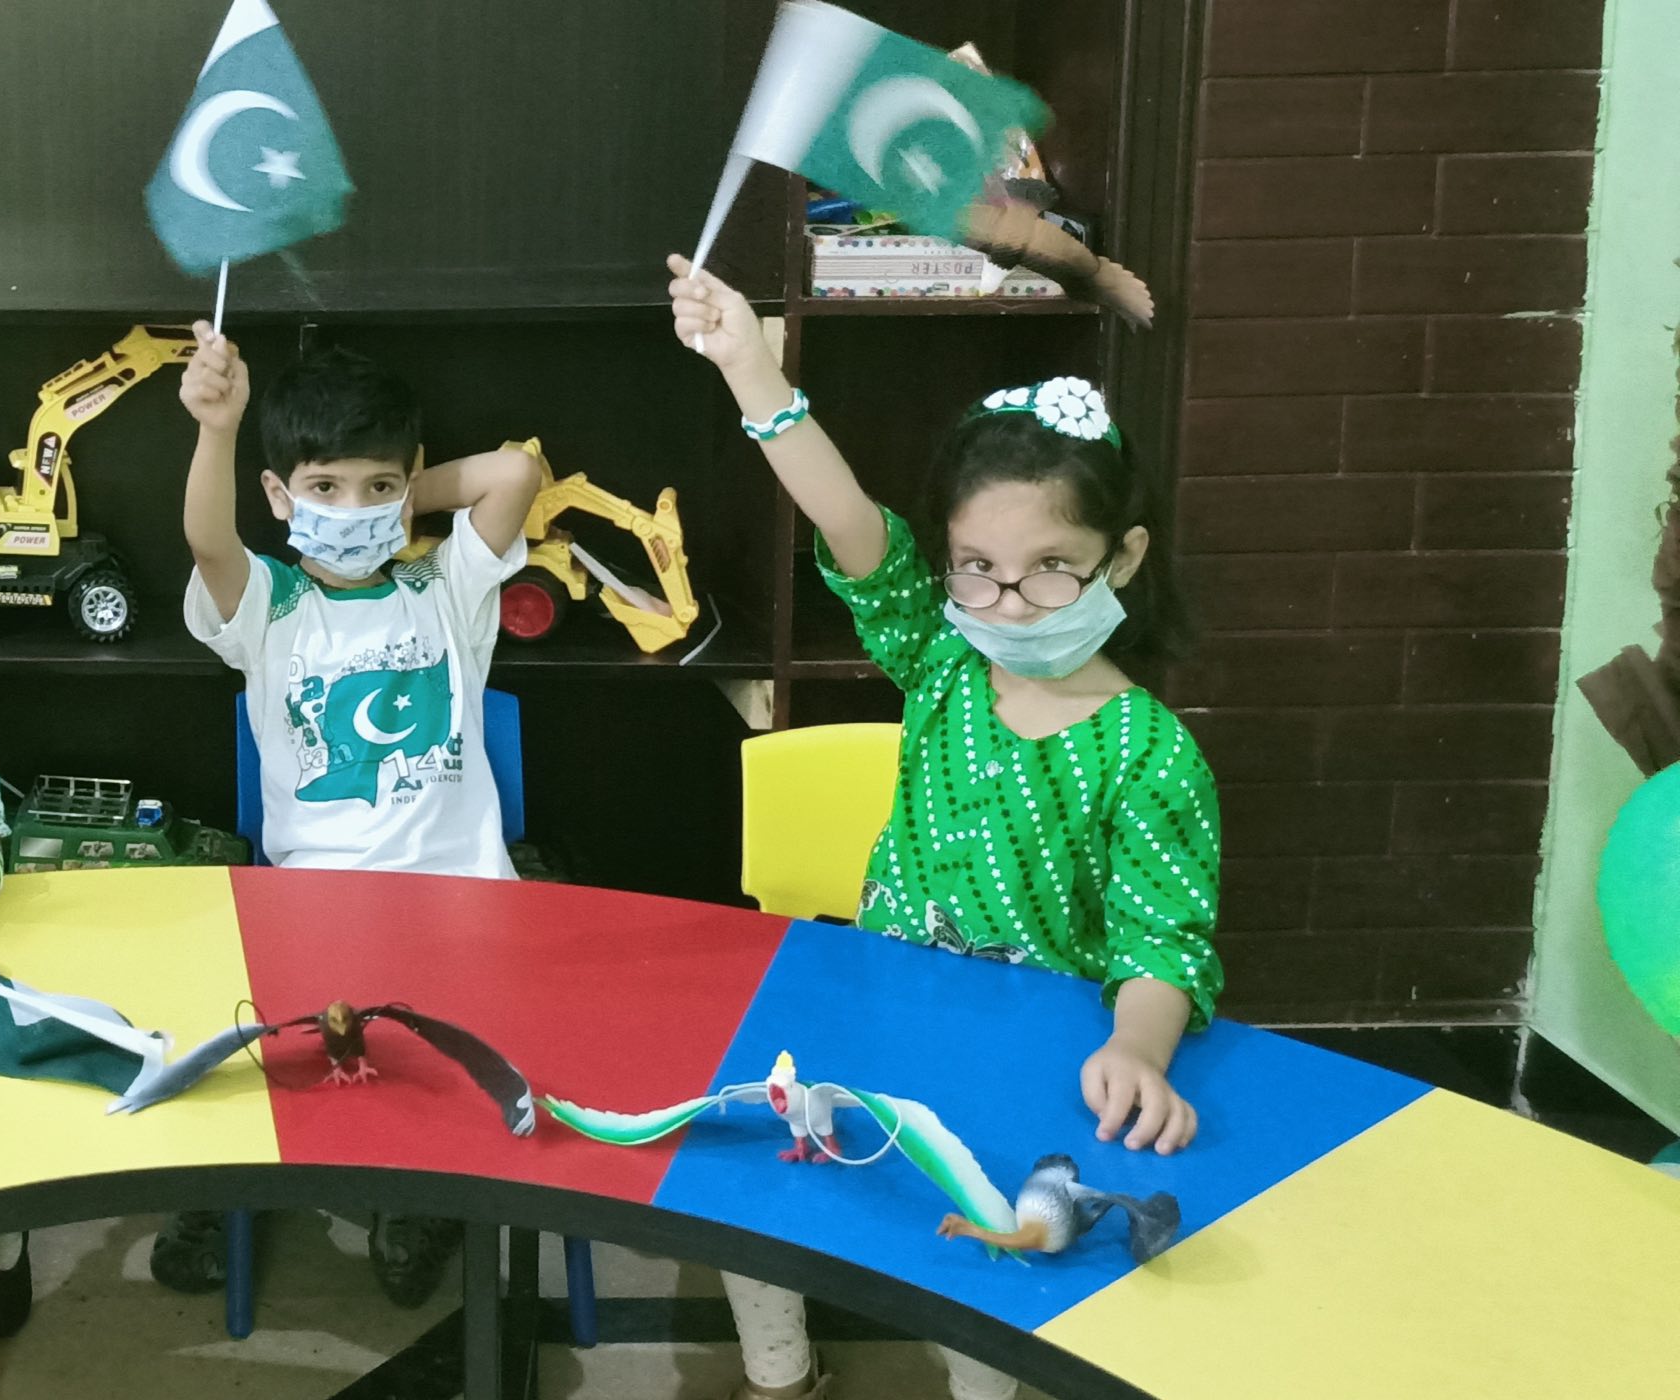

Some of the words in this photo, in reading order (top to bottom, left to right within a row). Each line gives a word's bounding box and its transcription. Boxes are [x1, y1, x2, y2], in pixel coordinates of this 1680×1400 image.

[911, 262, 974, 275] POSTER
[71, 393, 106, 417] POWER
[13, 535, 46, 545] POWER
